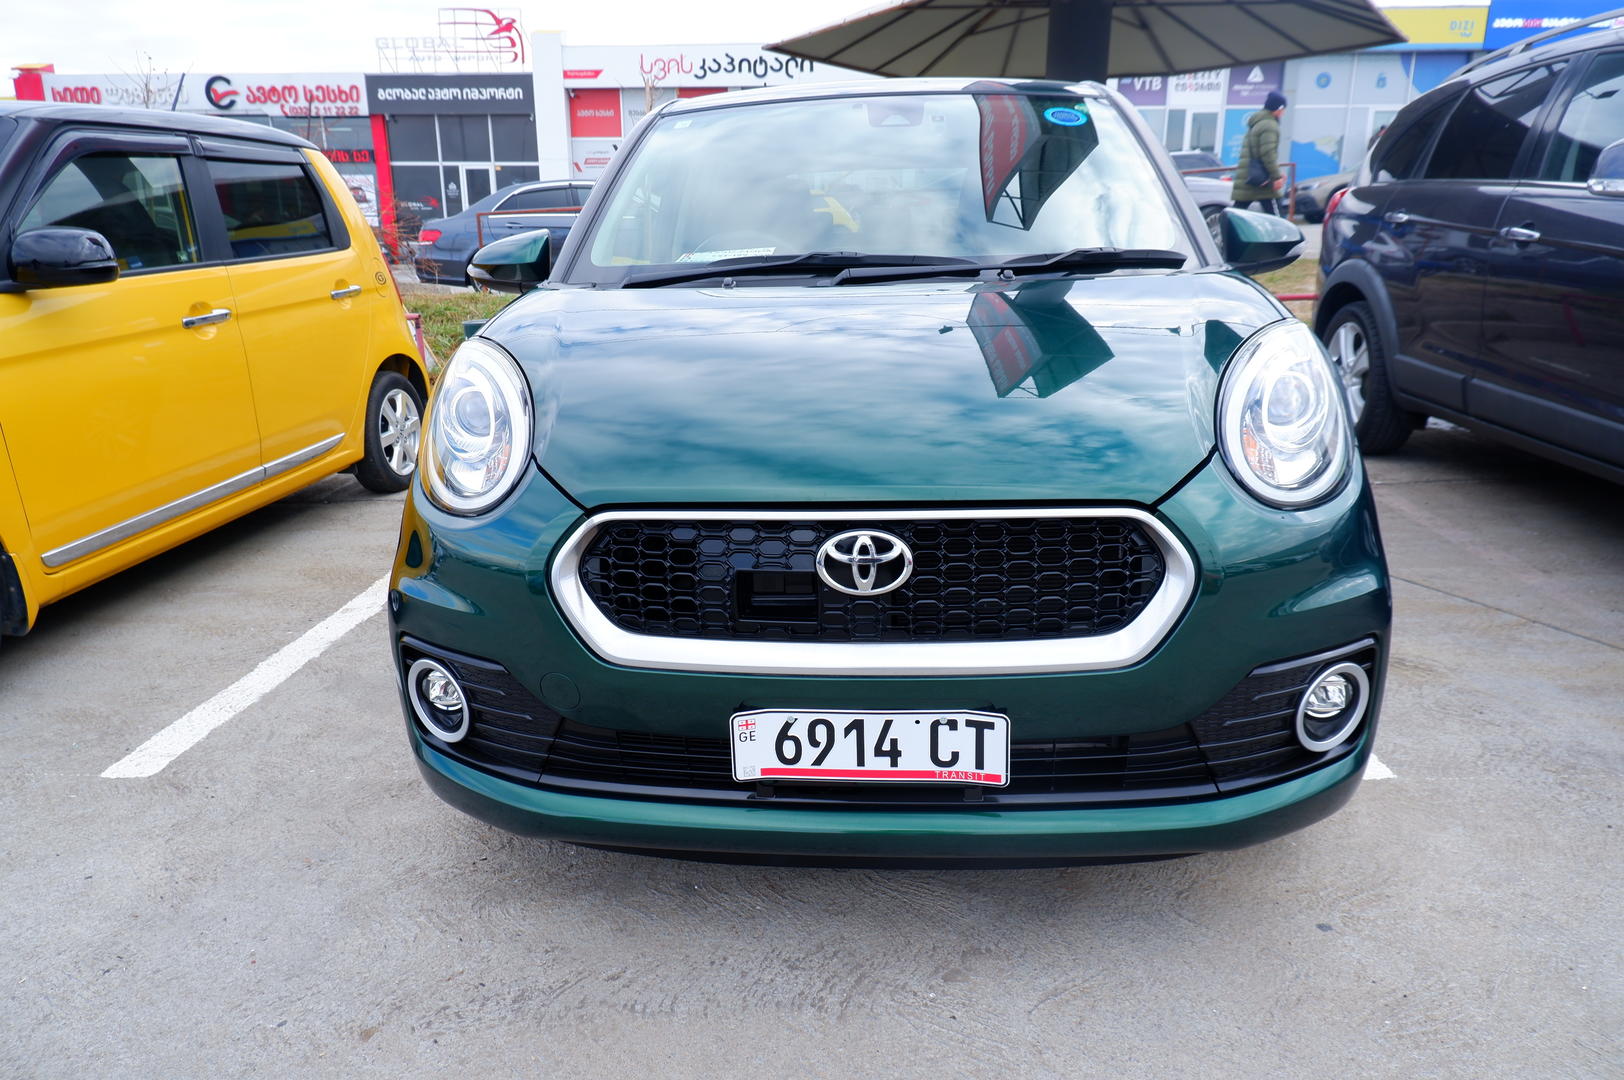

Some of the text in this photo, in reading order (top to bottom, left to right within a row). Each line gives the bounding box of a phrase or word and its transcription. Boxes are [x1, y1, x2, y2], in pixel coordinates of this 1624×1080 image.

[1133, 77, 1163, 92] VTB
[246, 84, 360, 104] ავტო სესხი
[739, 730, 757, 743] GE
[774, 717, 996, 771] 6914 CT
[935, 770, 986, 781] TRANSIT
